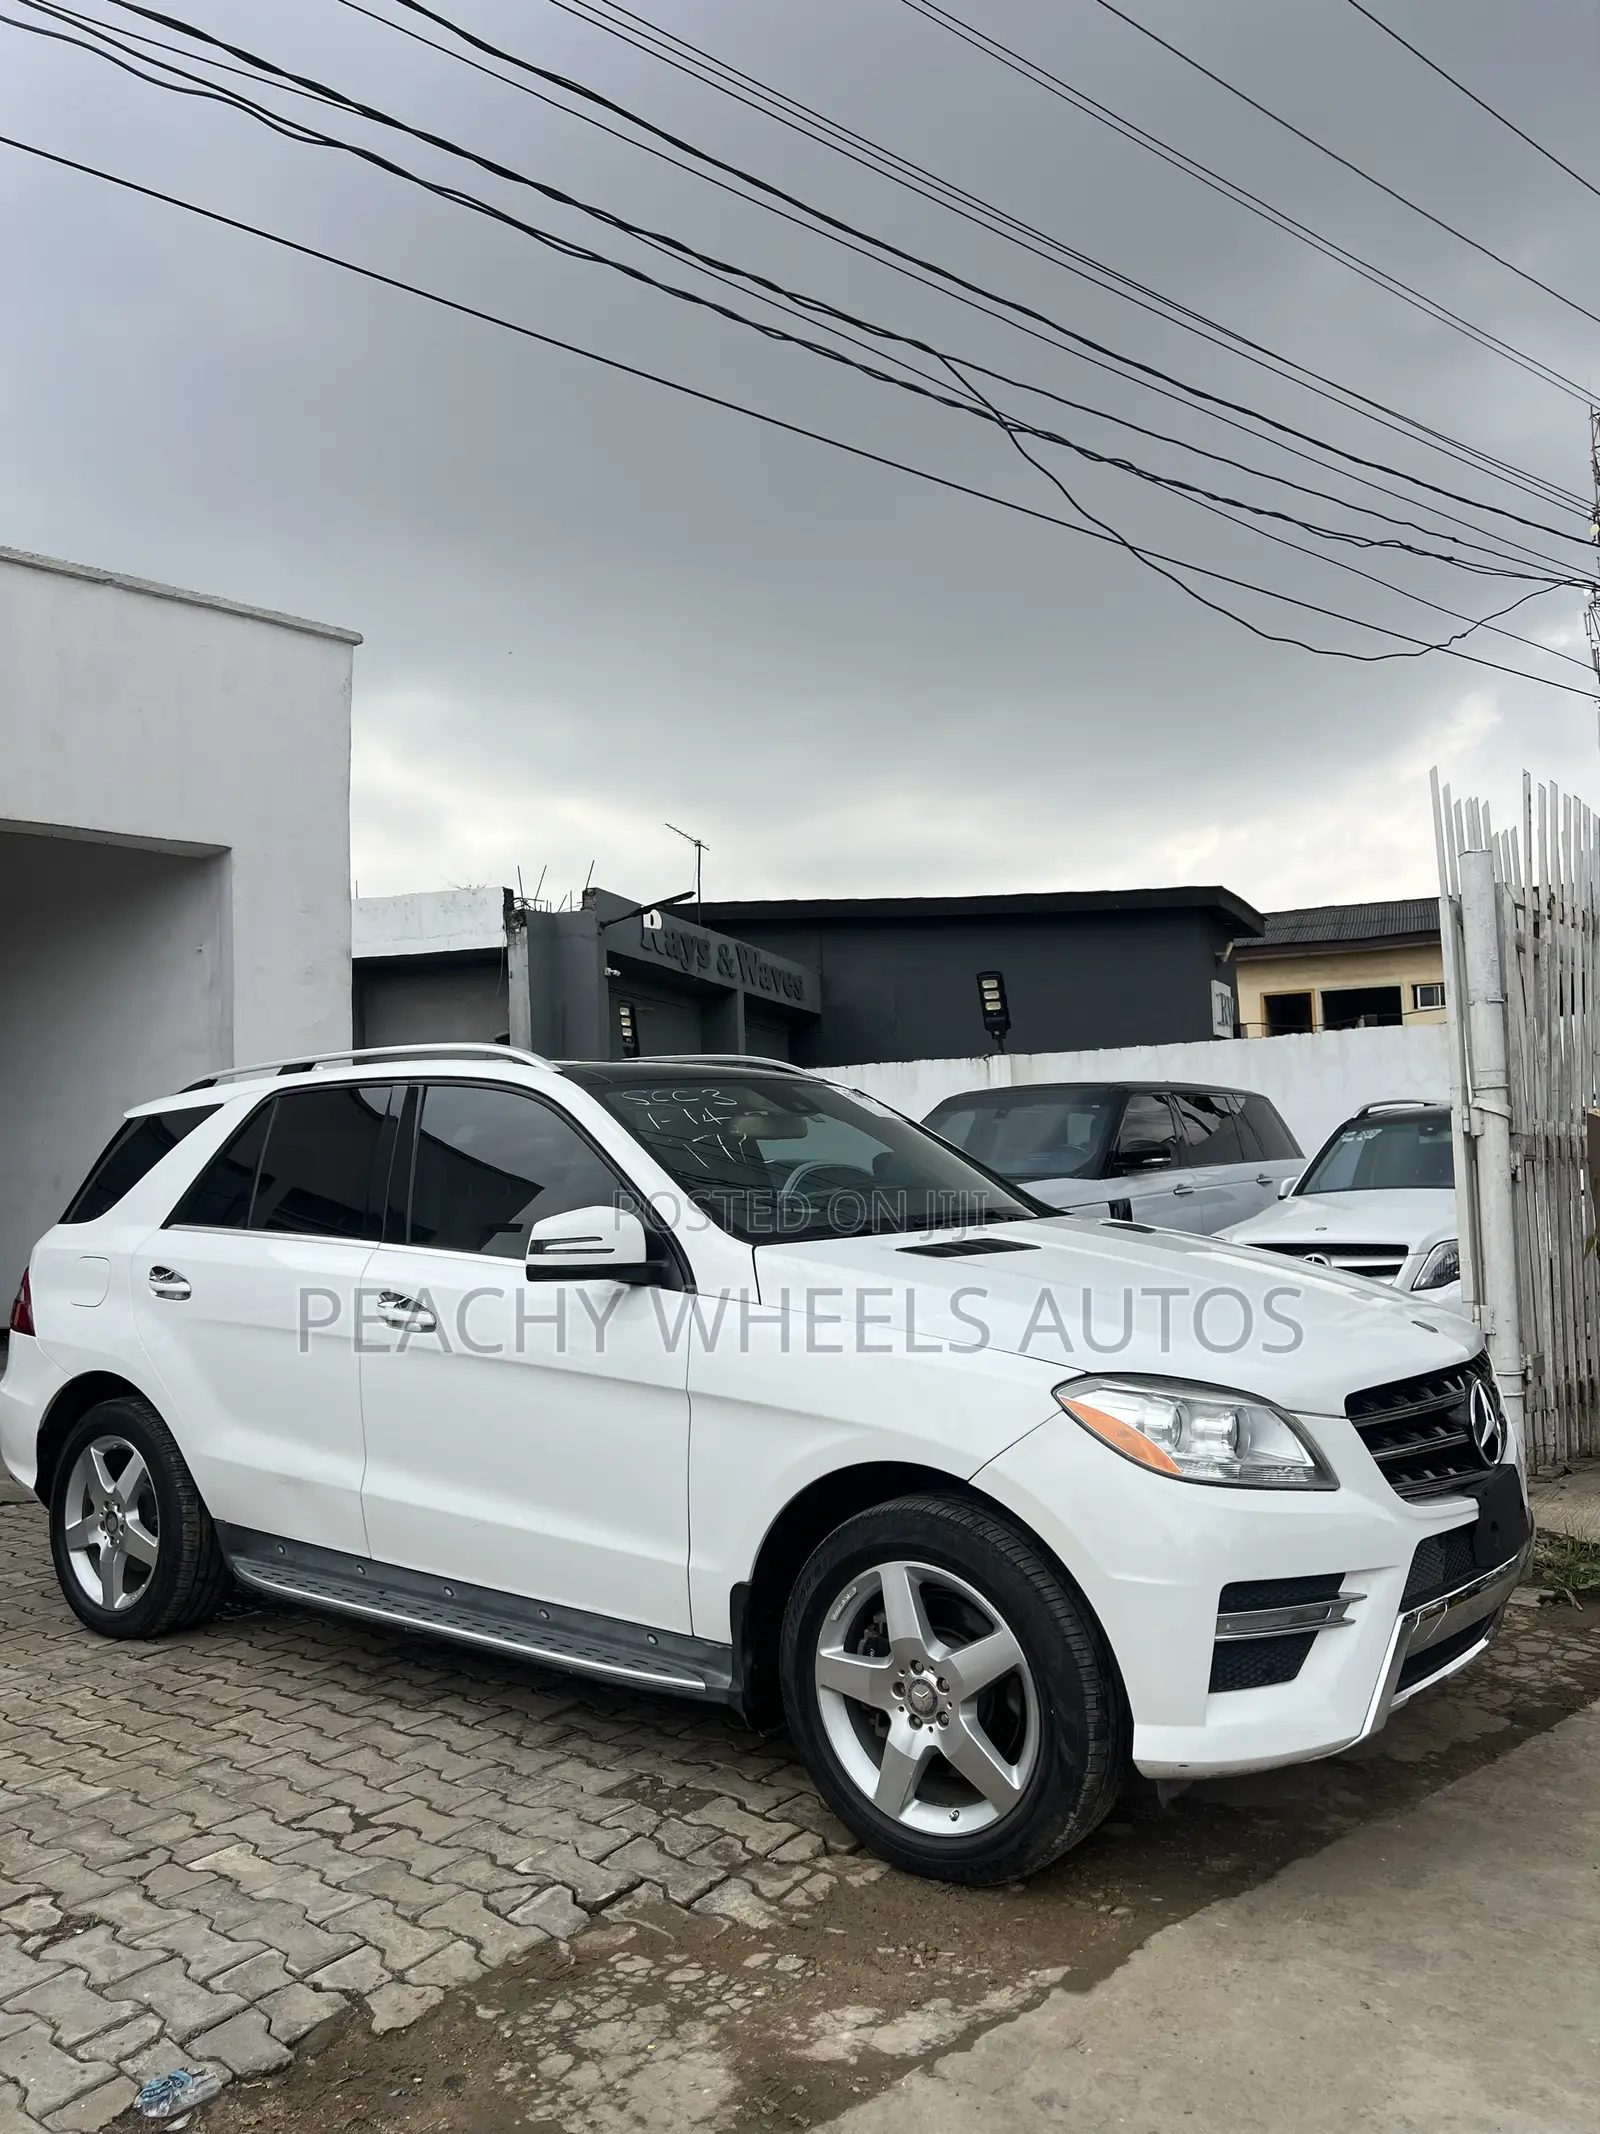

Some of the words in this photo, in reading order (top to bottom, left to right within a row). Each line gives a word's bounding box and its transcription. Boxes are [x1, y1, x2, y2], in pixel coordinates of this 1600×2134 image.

[640, 908, 711, 972] Rays
[716, 943, 738, 979] &
[735, 942, 805, 1001] Waves
